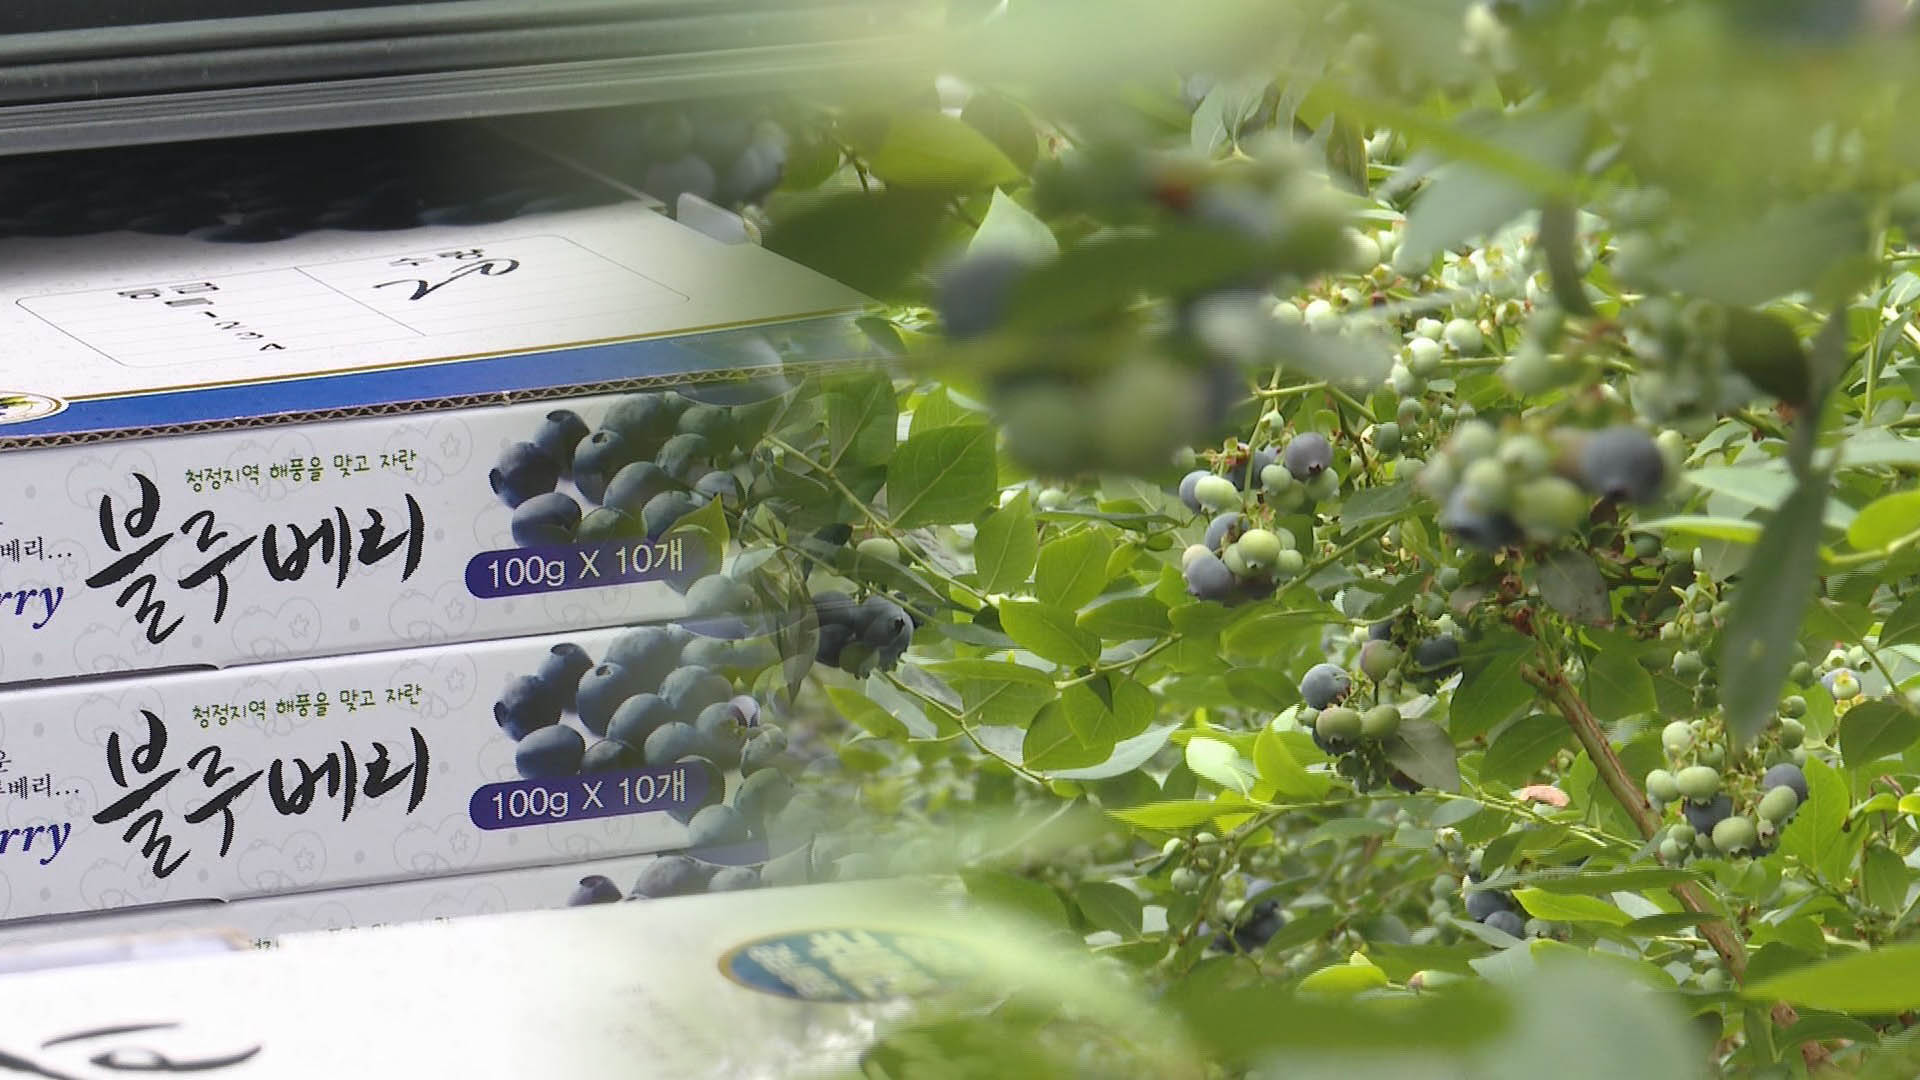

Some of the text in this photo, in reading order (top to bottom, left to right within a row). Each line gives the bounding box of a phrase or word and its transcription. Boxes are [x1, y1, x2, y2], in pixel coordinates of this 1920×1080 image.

[184, 449, 418, 494] 청정지역 해풍을 맞고 자란
[85, 472, 426, 645] 블루베리
[488, 537, 684, 590] 100g X 10개
[192, 683, 423, 729] 청정지역 해풍을 맞고 자란
[0, 773, 80, 800] 베리...
[92, 709, 430, 879] 블루베리
[492, 768, 686, 821] 100g X 10개
